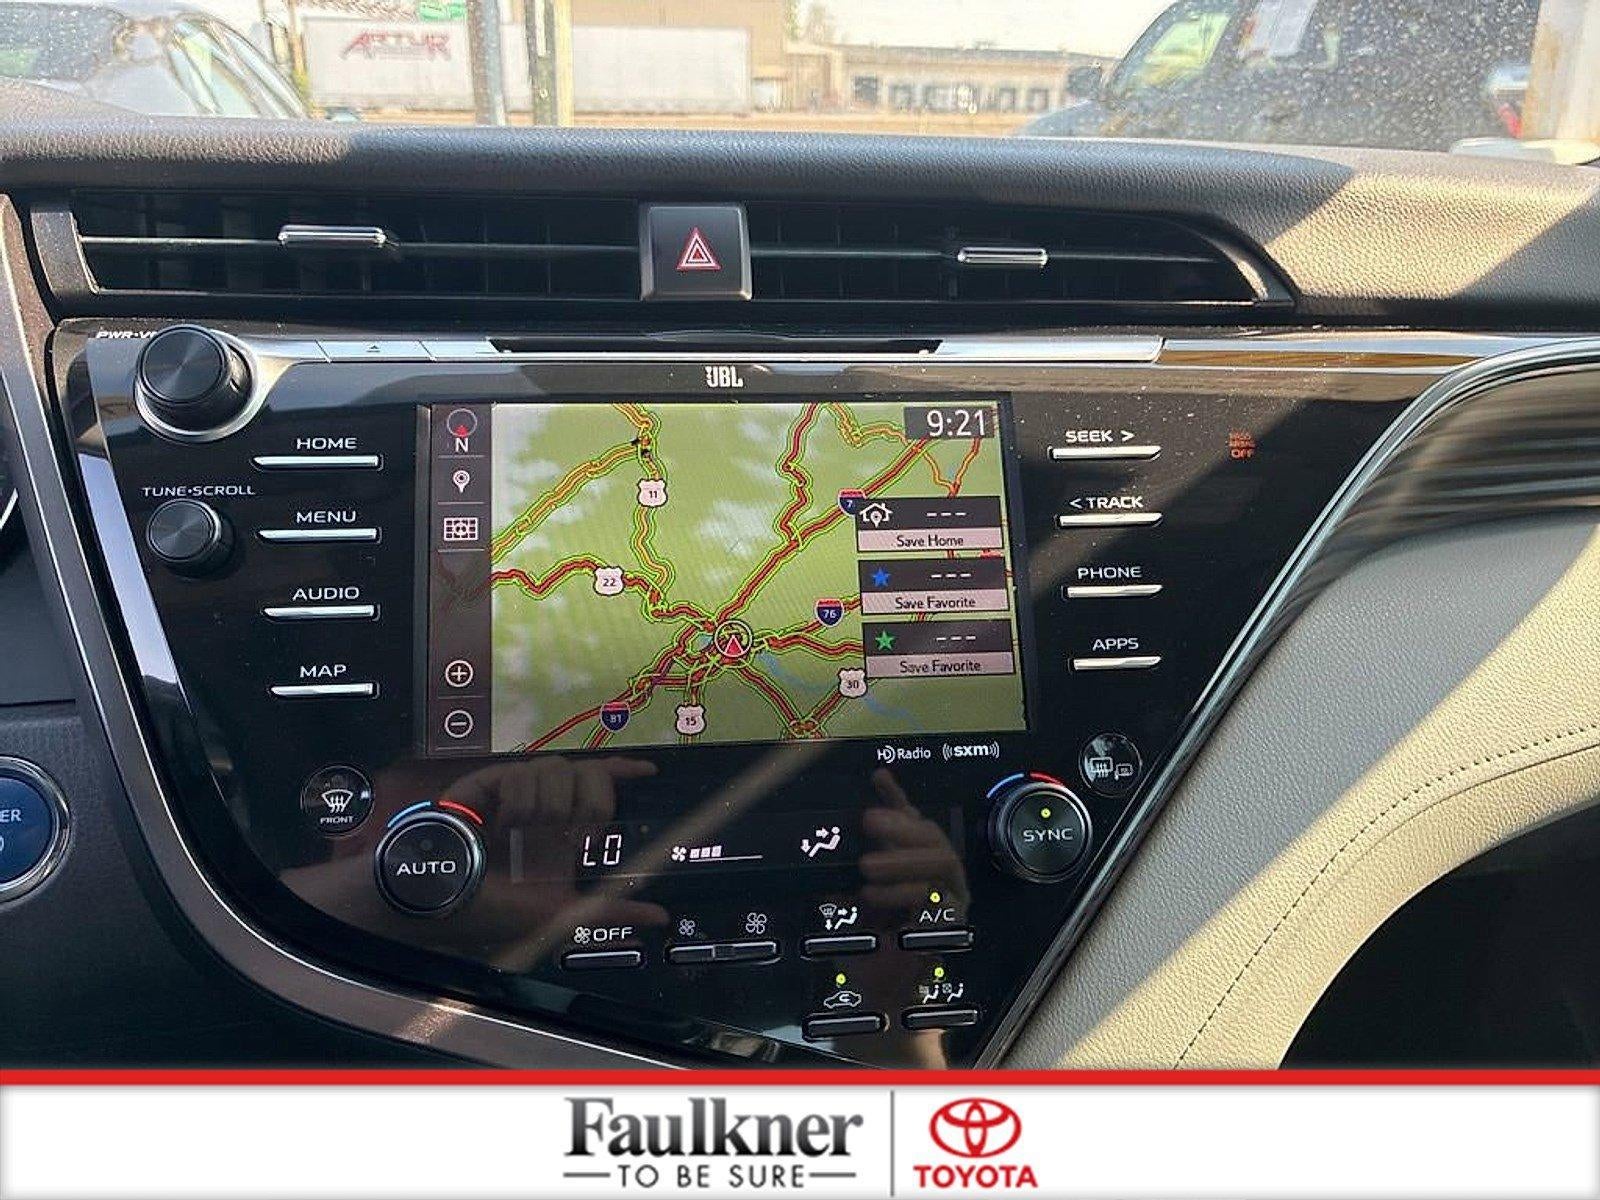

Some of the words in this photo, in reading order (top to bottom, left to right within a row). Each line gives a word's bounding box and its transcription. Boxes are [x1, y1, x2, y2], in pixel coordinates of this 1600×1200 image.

[705, 365, 743, 388] JBL
[926, 408, 986, 437] 9:21
[1065, 430, 1114, 443] SEEK
[296, 437, 357, 450] HOME
[454, 437, 469, 452] N
[648, 489, 658, 500] 11
[1086, 495, 1143, 509] TRACK
[296, 511, 357, 524] MENU
[896, 534, 925, 547] Save
[928, 534, 964, 547] Home
[1077, 567, 1142, 580] PHONE
[603, 578, 616, 588] 22
[292, 587, 360, 600] AUDIO
[895, 596, 924, 610] Save
[927, 595, 976, 608] Favorite
[823, 609, 837, 620] 76
[1092, 638, 1140, 651] APPS
[299, 665, 347, 678] MAP
[899, 660, 929, 674] Save
[932, 659, 981, 672] Favorite
[846, 679, 860, 690] 30
[685, 715, 697, 727] 15
[897, 747, 932, 759] Radio
[0, 809, 22, 823] ER
[320, 815, 354, 824] FRONT
[1023, 827, 1074, 843] SYNC
[396, 860, 456, 876] AUTO
[919, 907, 955, 923] A/C
[593, 927, 633, 942] OFF
